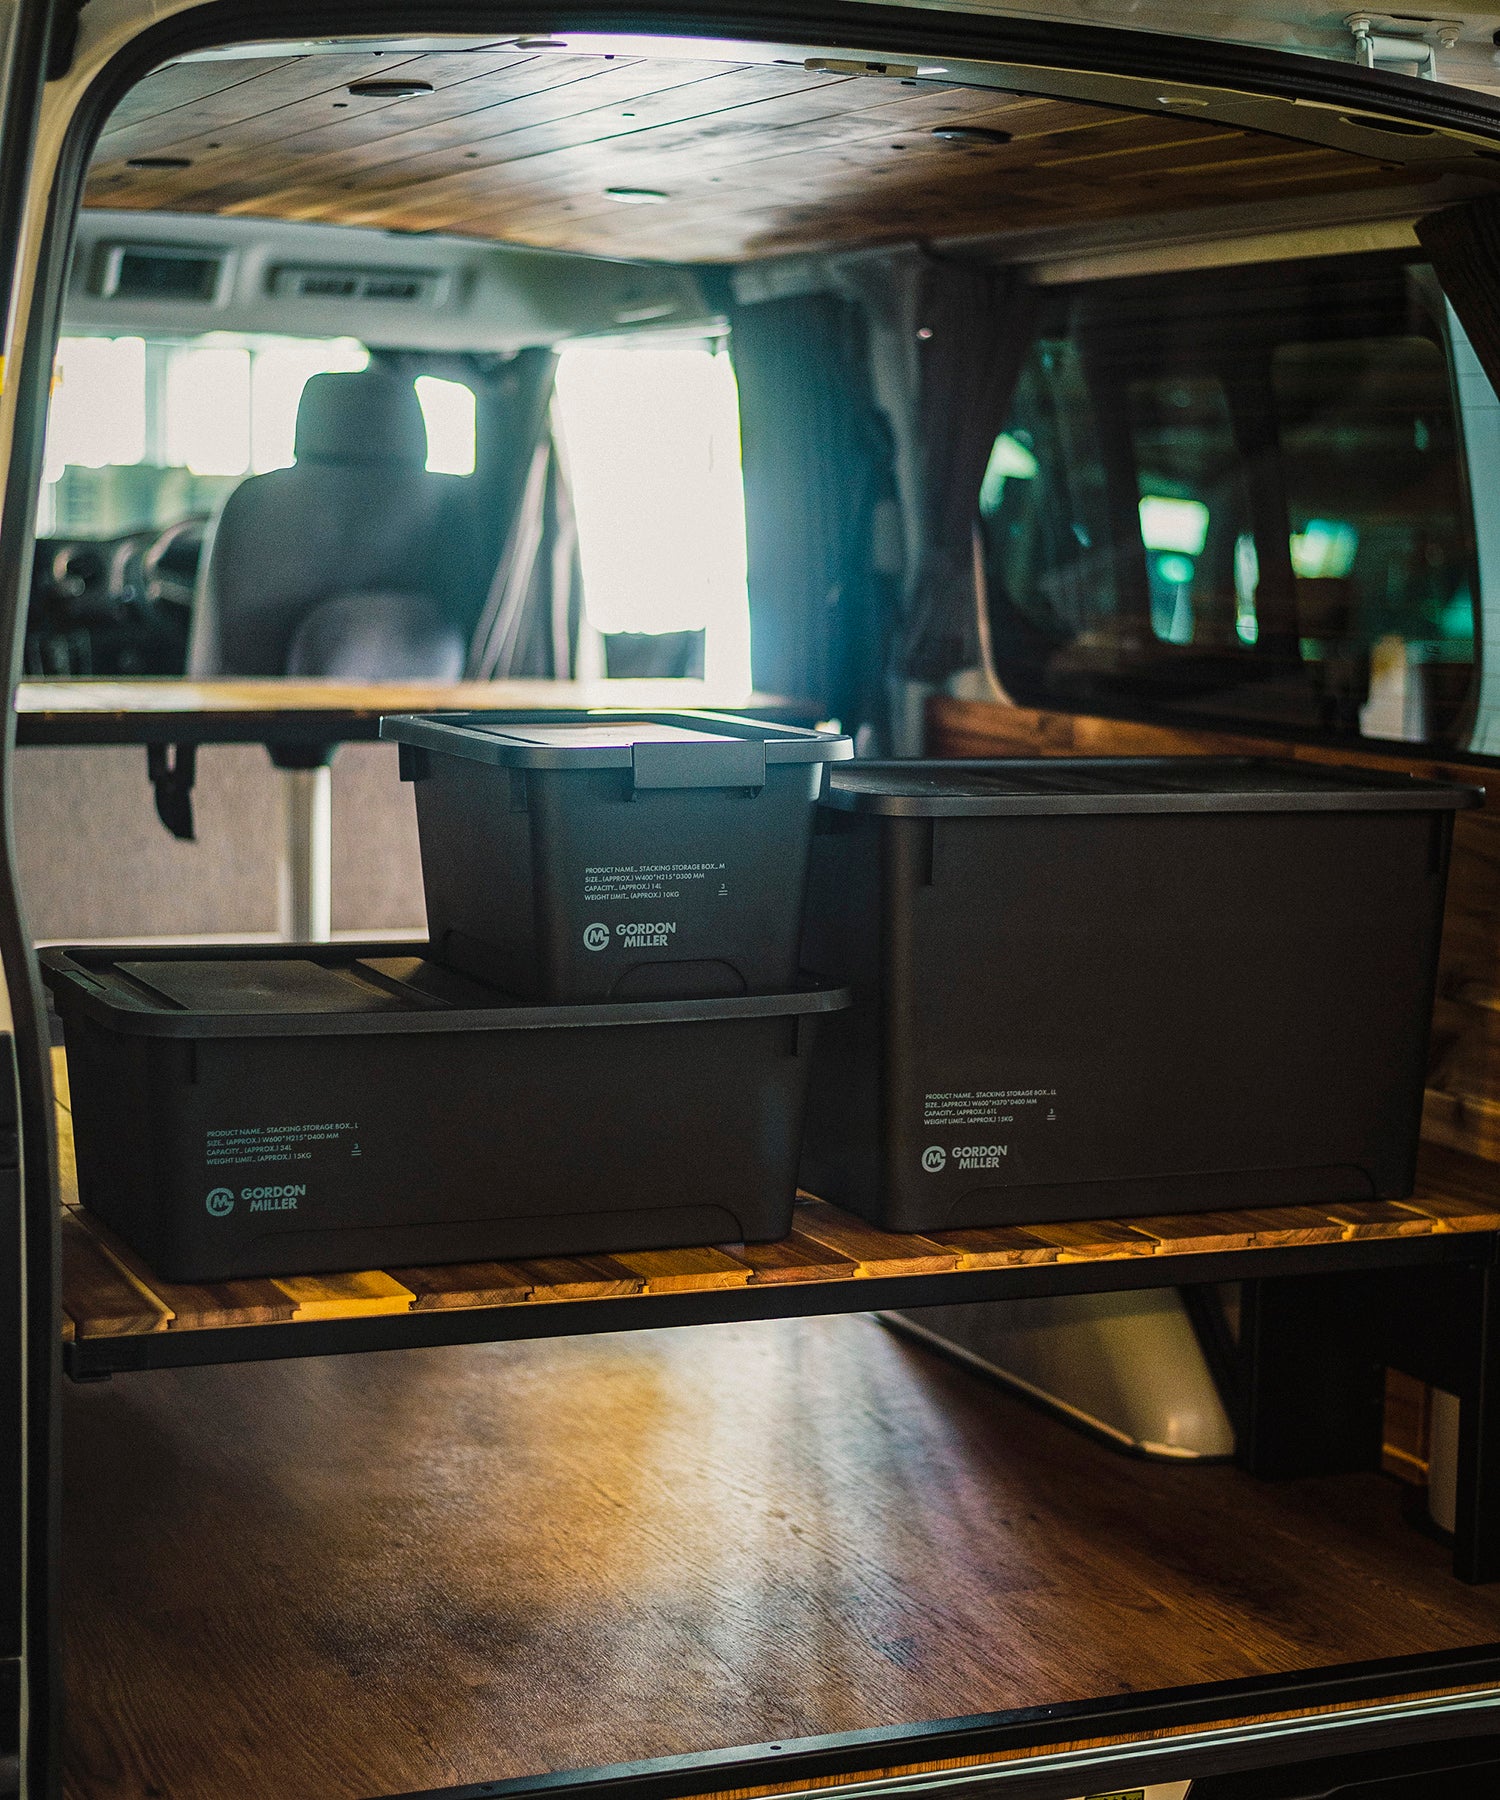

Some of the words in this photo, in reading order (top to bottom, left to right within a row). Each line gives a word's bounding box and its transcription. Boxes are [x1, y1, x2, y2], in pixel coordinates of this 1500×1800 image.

[639, 864, 671, 872] STACKING
[615, 922, 676, 936] GORDON
[623, 934, 669, 948] MILLER
[207, 1129, 238, 1137] PRODUCT
[952, 1145, 1008, 1158] GORDON
[958, 1157, 1000, 1170] MILLER
[241, 1184, 307, 1200] GORDON
[249, 1198, 298, 1212] MILLER
